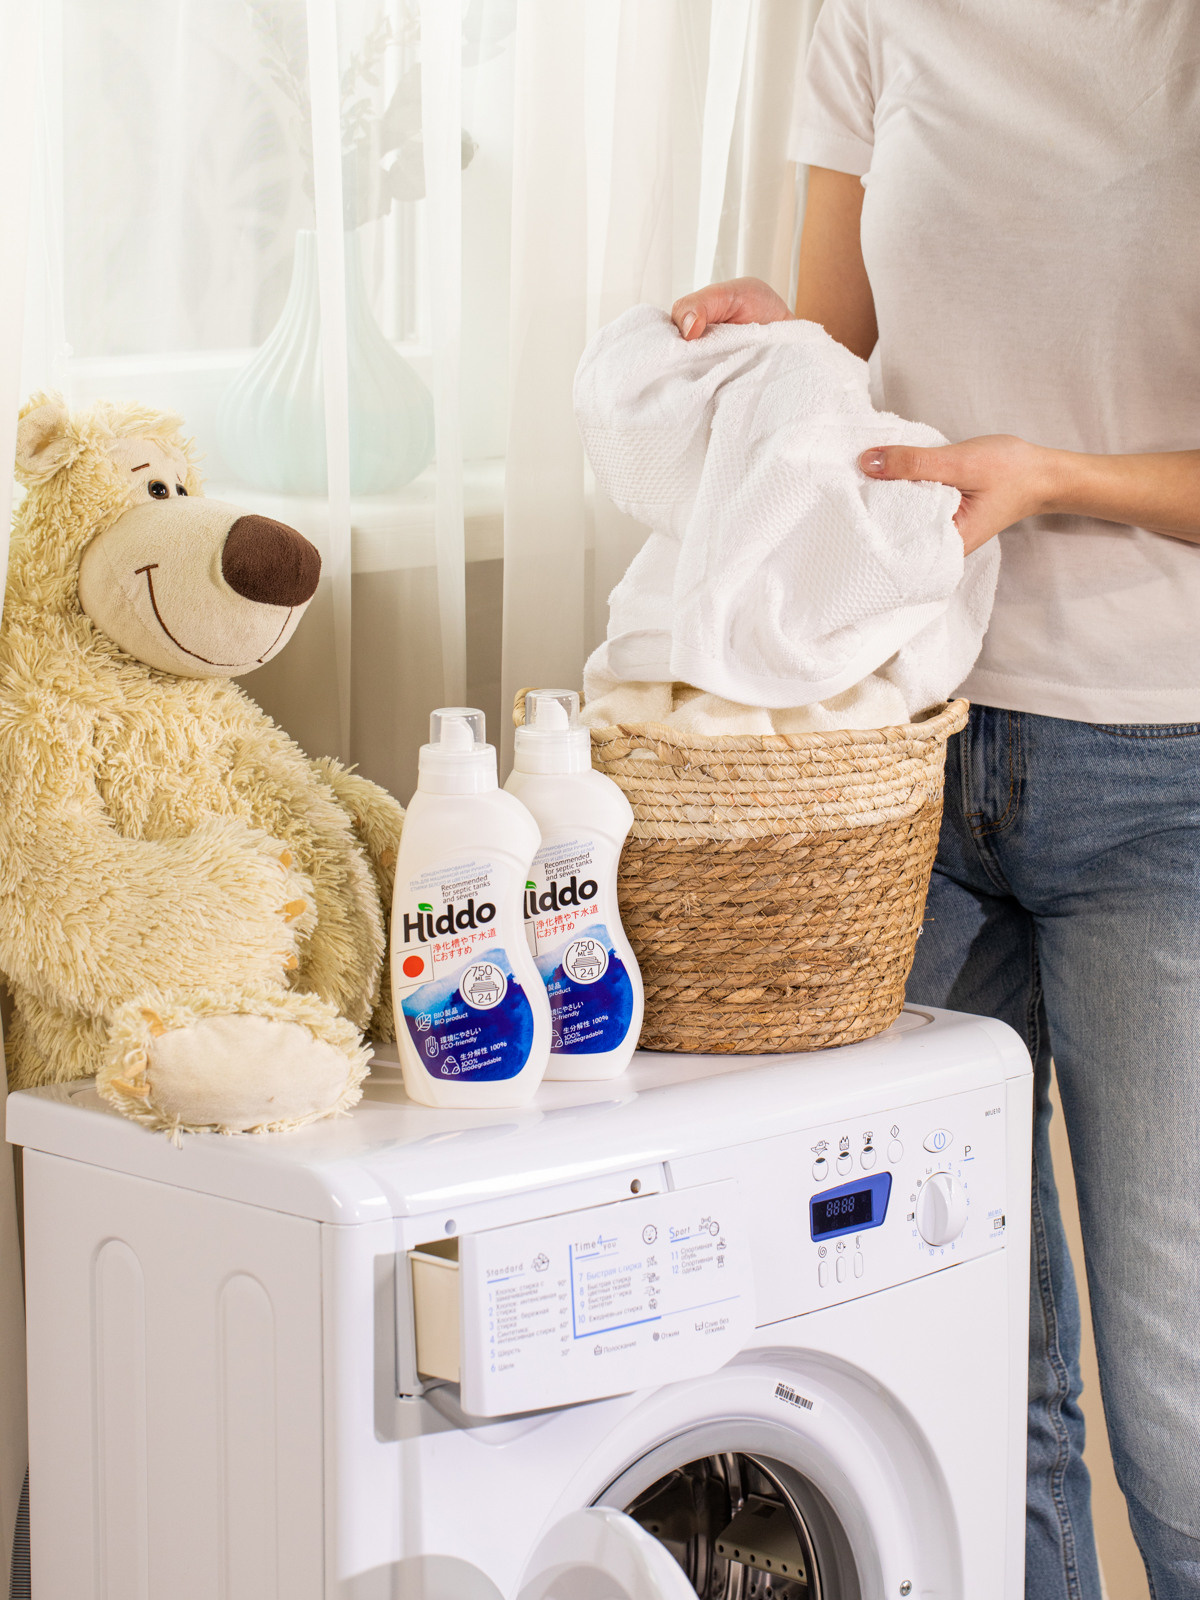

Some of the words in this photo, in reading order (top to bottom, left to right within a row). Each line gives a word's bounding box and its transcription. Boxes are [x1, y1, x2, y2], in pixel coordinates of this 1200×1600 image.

[544, 852, 590, 869] Recommended
[545, 868, 554, 876] for
[556, 865, 574, 874] septic
[575, 859, 593, 868] tanks
[546, 873, 558, 882] and
[559, 869, 581, 879] sewers
[441, 875, 488, 891] Recommended
[452, 886, 472, 896] septic
[473, 881, 491, 891] tanks
[443, 895, 455, 904] and
[456, 891, 479, 901] sewers
[403, 898, 496, 943] Hiddo
[536, 904, 599, 930] 浄化槽や下水道
[537, 922, 575, 939] におすすめ
[432, 927, 497, 953] 浄化槽や下水道
[574, 940, 595, 953] 750
[433, 946, 472, 963] におすすめ
[471, 964, 493, 978] 750
[580, 967, 594, 978] 24
[477, 993, 491, 1003] 24
[549, 987, 571, 998] product
[434, 1018, 445, 1026] BIO
[445, 1012, 468, 1024] product
[552, 1010, 579, 1022] O-friendly
[563, 1020, 590, 1034] 生分解性
[592, 1015, 609, 1025] 100%
[440, 1027, 481, 1044] 環境にやさしい
[564, 1032, 581, 1041] 100%
[441, 1037, 477, 1051] ECO-friendly
[460, 1046, 488, 1061] 生分解性
[490, 1041, 507, 1051] 100%
[461, 1058, 478, 1067] 100%
[965, 1145, 972, 1157] P
[669, 1227, 690, 1239] Sport
[574, 1242, 596, 1252] Time
[486, 1263, 524, 1278] Standard
